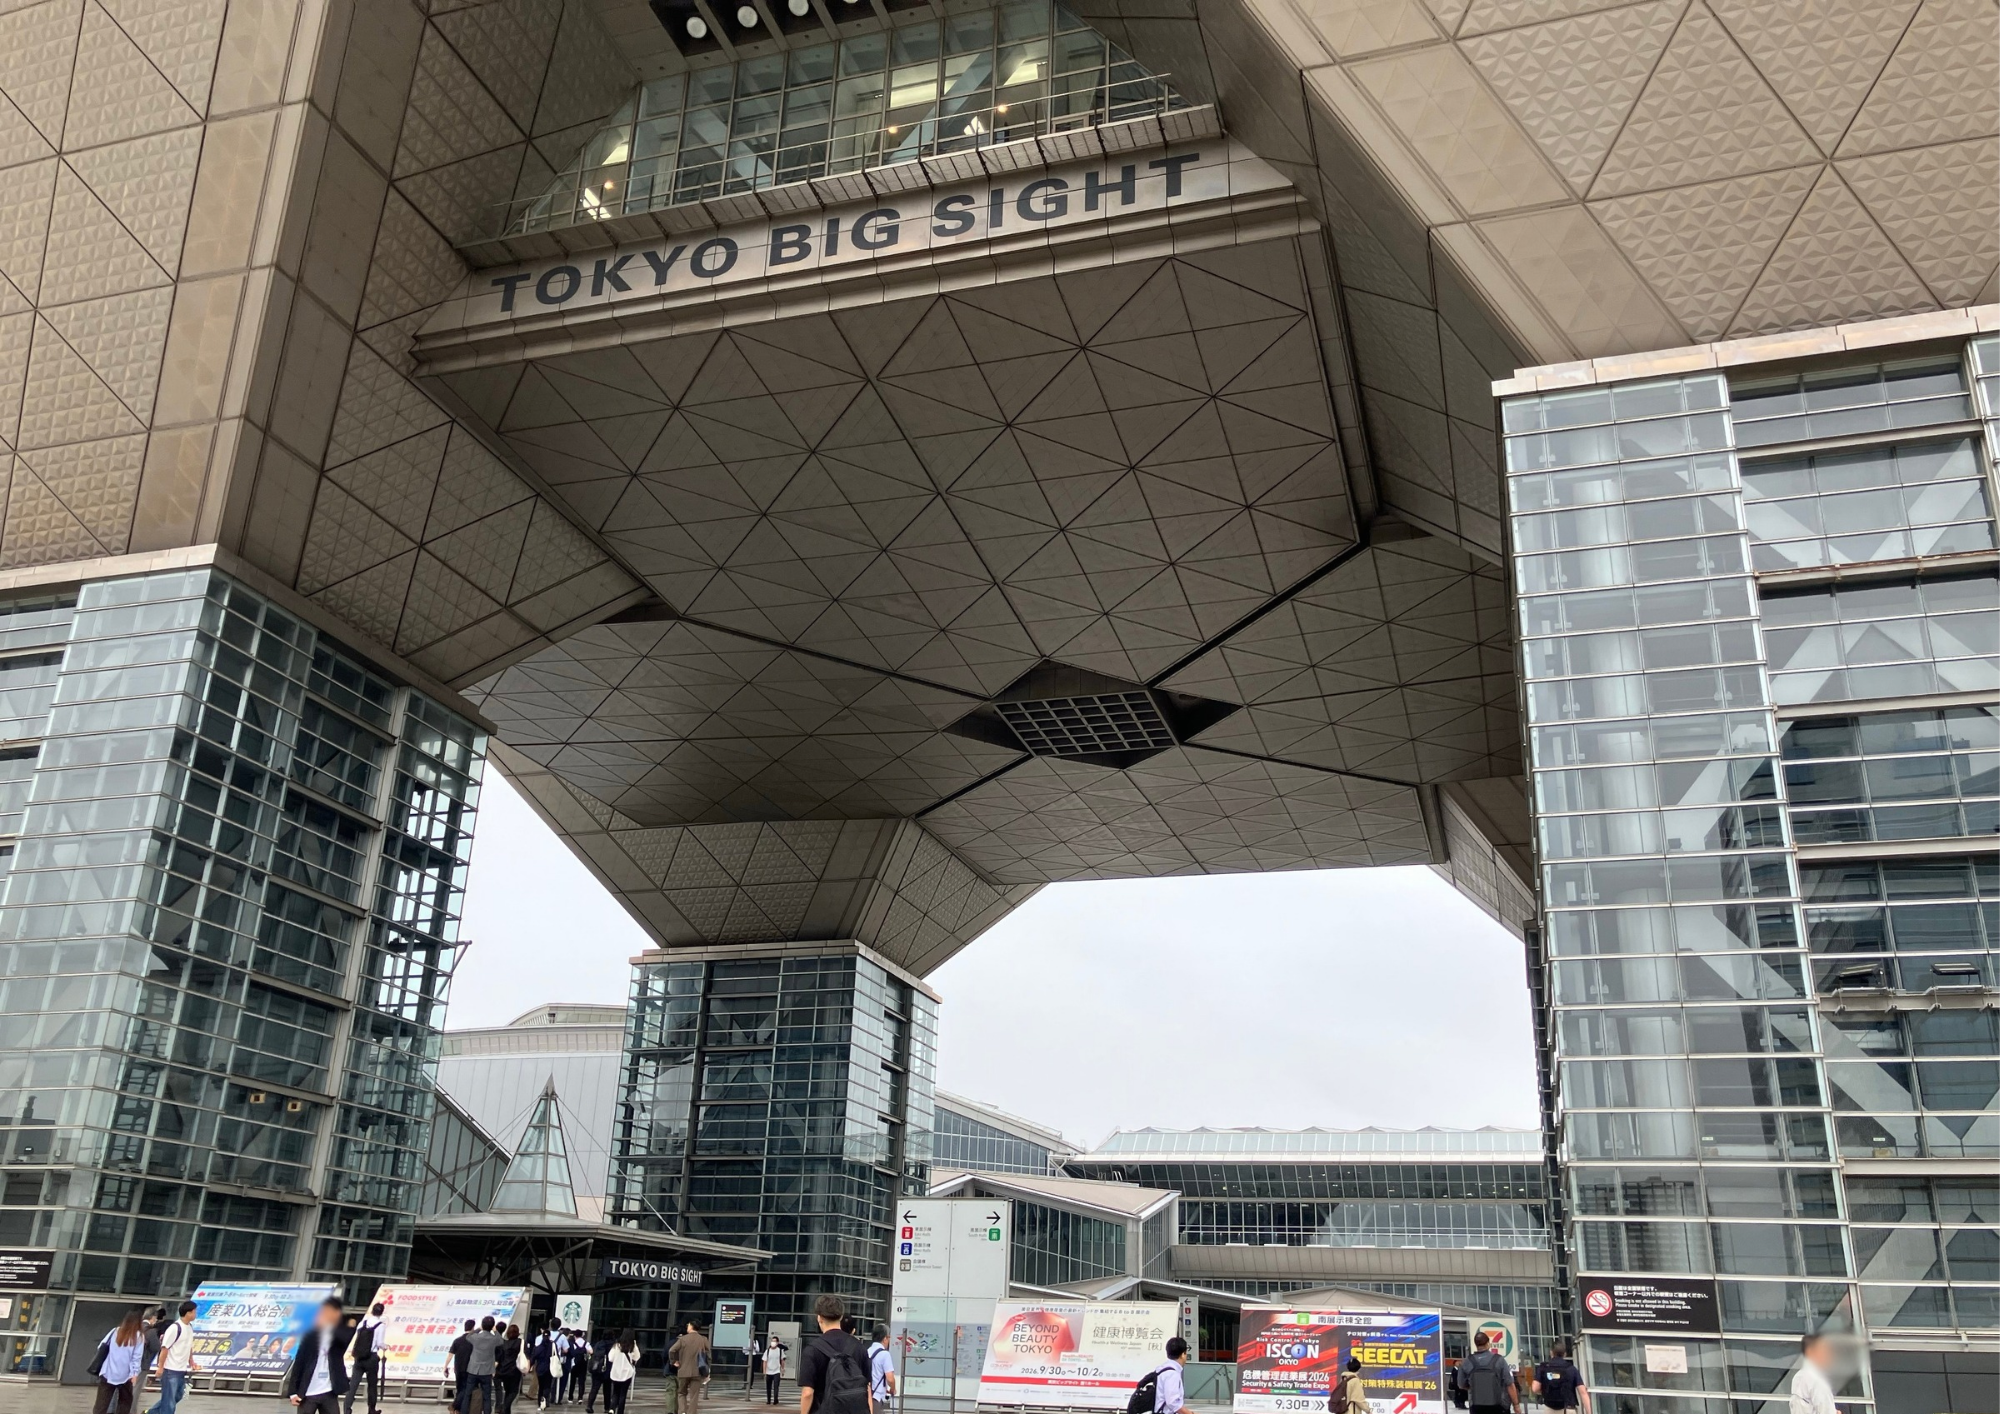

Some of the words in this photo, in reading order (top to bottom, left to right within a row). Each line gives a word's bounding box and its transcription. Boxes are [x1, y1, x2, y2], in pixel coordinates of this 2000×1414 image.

[491, 236, 740, 313] TOKYO
[768, 207, 902, 268] BIG
[931, 153, 1201, 239] SIGHT
[609, 1260, 658, 1278] TOKYO
[660, 1266, 679, 1281] BIG
[680, 1268, 703, 1284] SIGHT
[1013, 1323, 1060, 1334] BEYOND
[1093, 1326, 1164, 1340] 健康博覧会
[1012, 1333, 1057, 1344] BEAUTY
[1014, 1344, 1053, 1354] TOKYO
[1255, 1343, 1320, 1359] RISCON
[1350, 1347, 1428, 1365] SEECAT
[1242, 1380, 1267, 1388] Security
[1273, 1381, 1293, 1389] Safety
[1313, 1382, 1330, 1390] Expo
